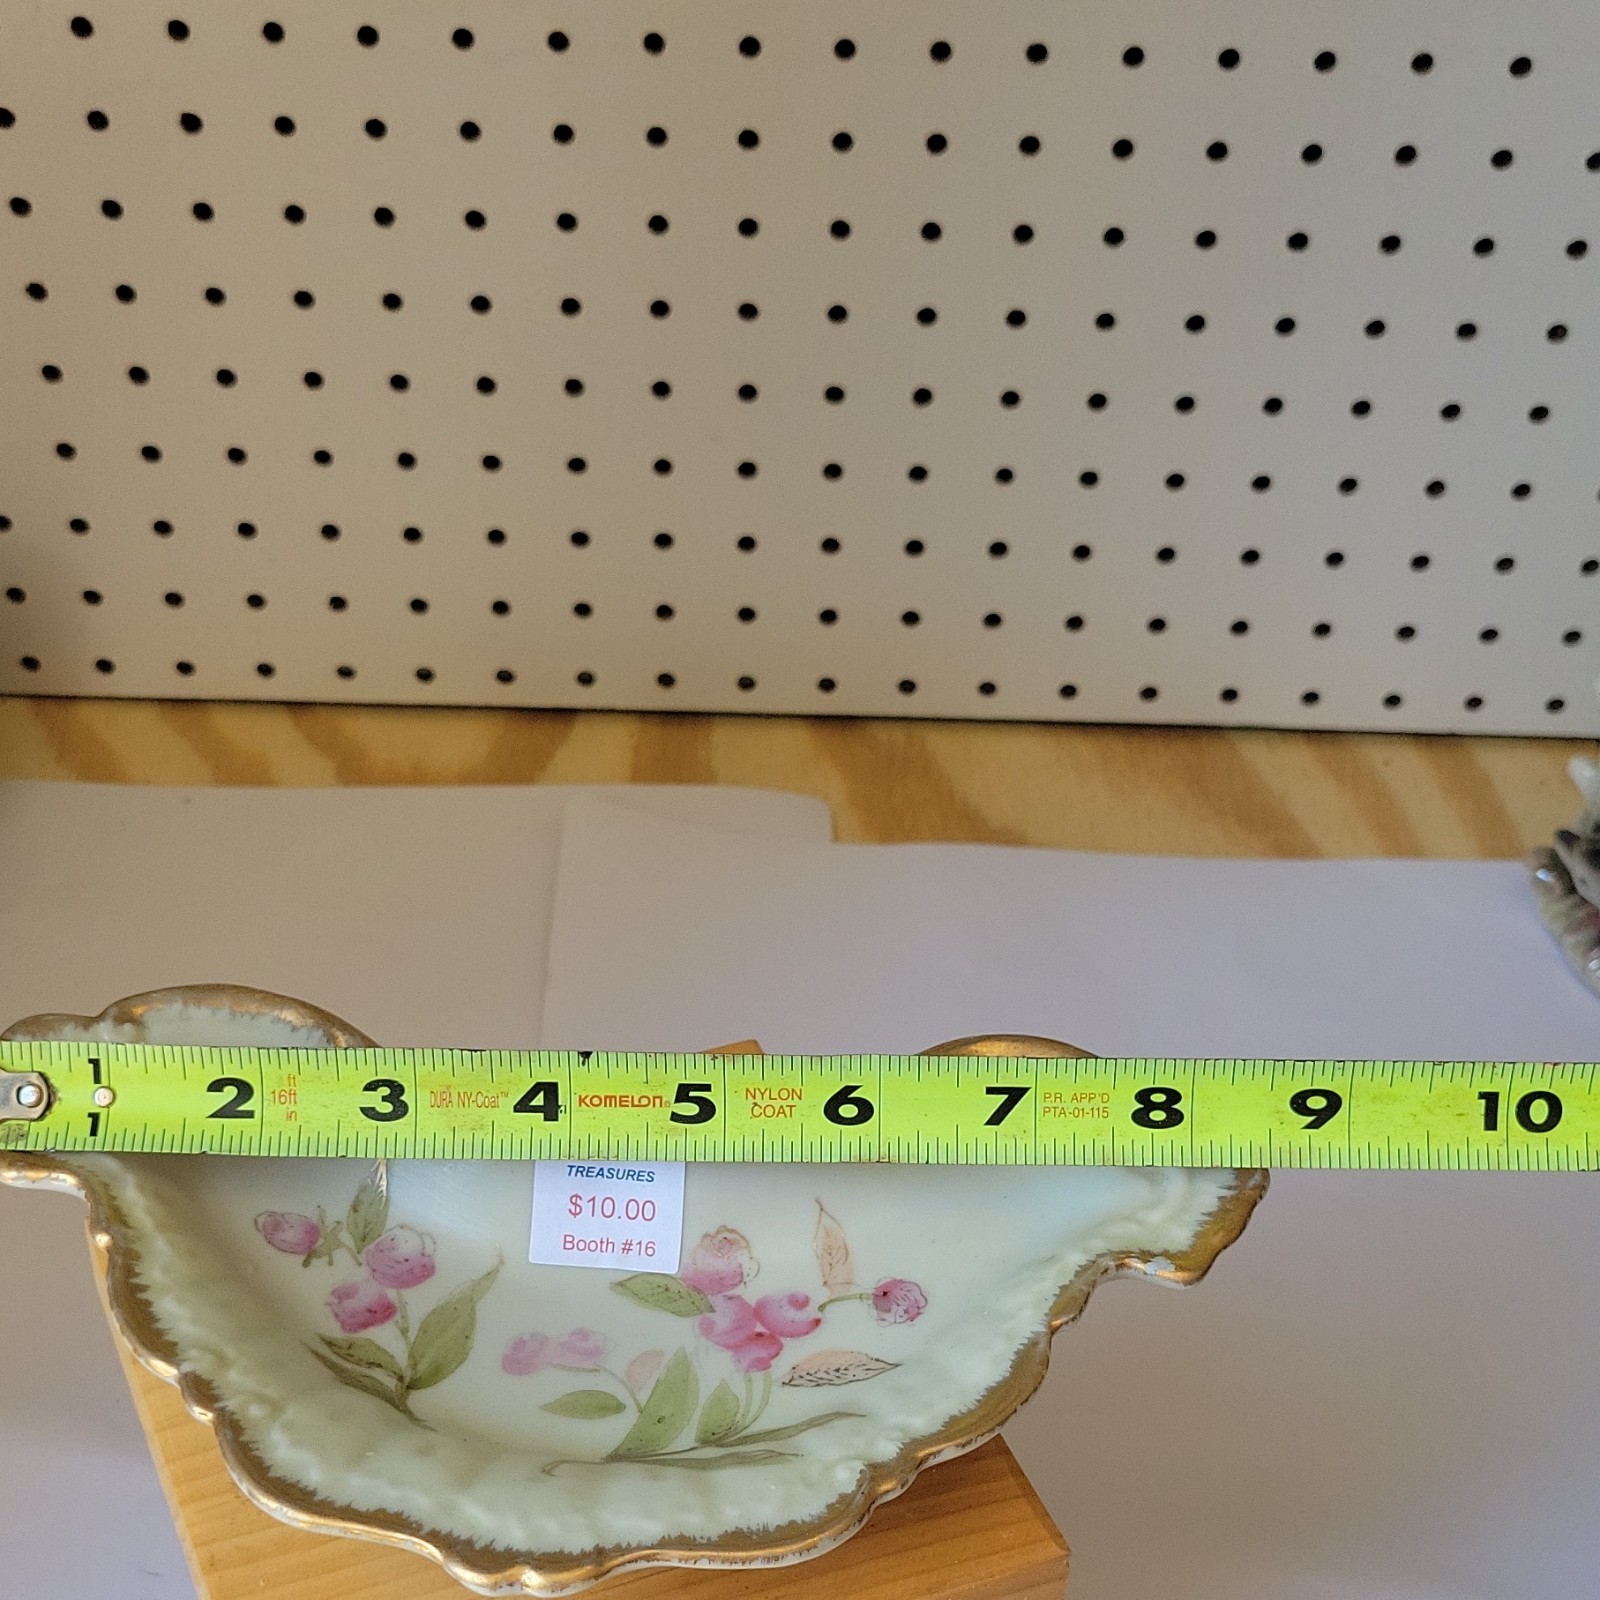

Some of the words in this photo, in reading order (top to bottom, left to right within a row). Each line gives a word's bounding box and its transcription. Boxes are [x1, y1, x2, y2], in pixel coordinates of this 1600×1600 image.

[87, 1058, 101, 1084] 1
[206, 1077, 256, 1119] 2
[271, 1089, 298, 1105] 16ft
[358, 1078, 409, 1122] 3
[429, 1090, 454, 1109] DURA
[513, 1081, 560, 1122] 4
[669, 1083, 717, 1125] 5
[745, 1087, 803, 1101] NYLON
[823, 1085, 875, 1126] 6
[983, 1086, 1032, 1126] 7
[1043, 1092, 1067, 1104] P.R.
[751, 1104, 797, 1118] COAT
[1043, 1106, 1110, 1119] PTA-01-115
[1130, 1086, 1185, 1130] 8
[1289, 1088, 1343, 1130] 9
[1477, 1091, 1563, 1133] 10
[87, 1112, 101, 1137] 1
[567, 1164, 656, 1182] TREASURES
[568, 1193, 656, 1222] $10.00
[563, 1234, 615, 1253] Booth
[621, 1238, 656, 1257] #16
